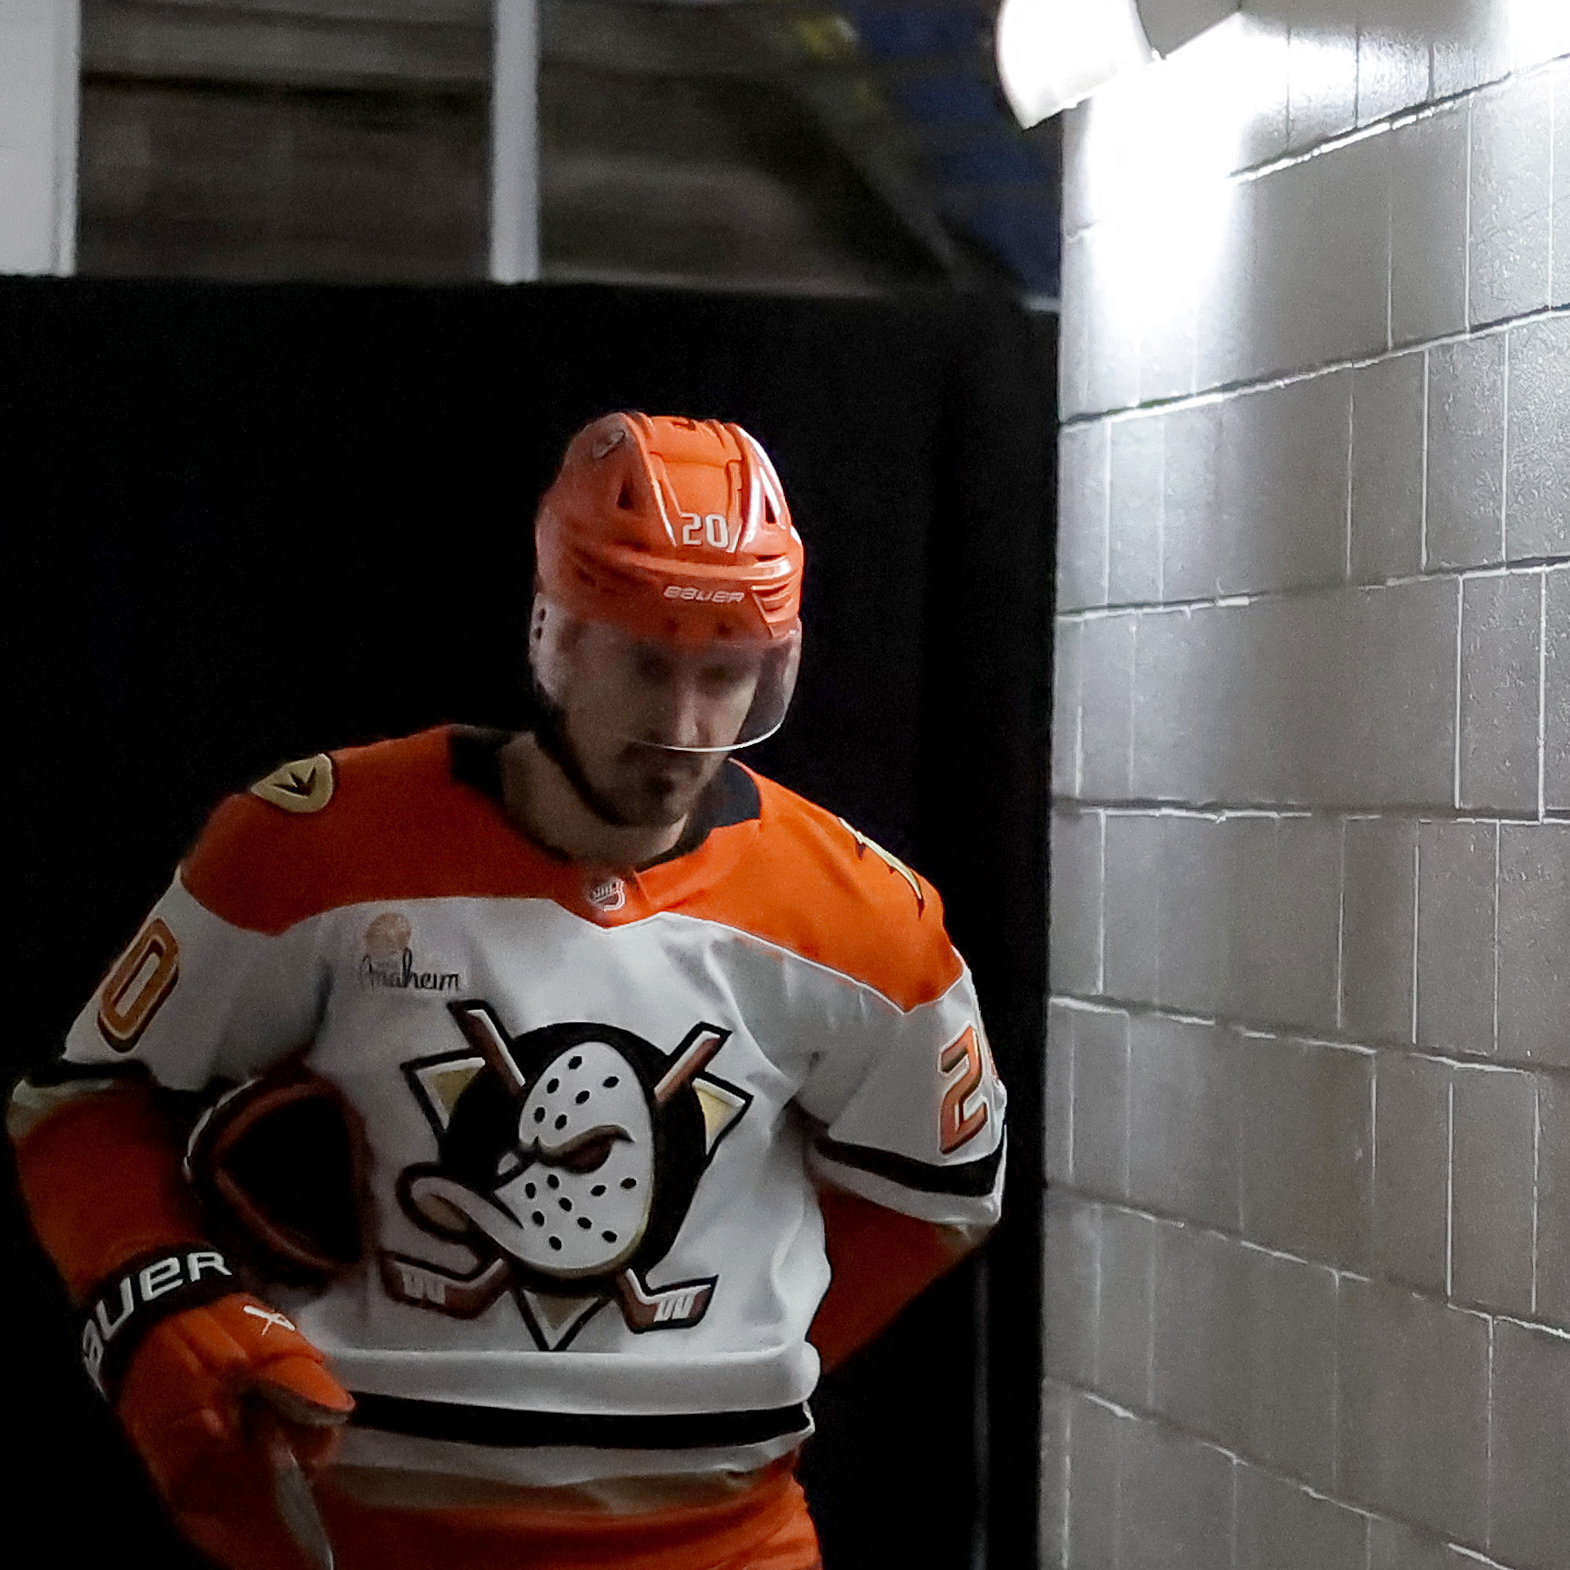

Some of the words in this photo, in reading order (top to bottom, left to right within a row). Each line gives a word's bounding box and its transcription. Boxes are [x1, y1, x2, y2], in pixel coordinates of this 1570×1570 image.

[680, 513, 729, 547] 20
[663, 585, 745, 603] BAUER
[81, 1251, 232, 1400] AUER
